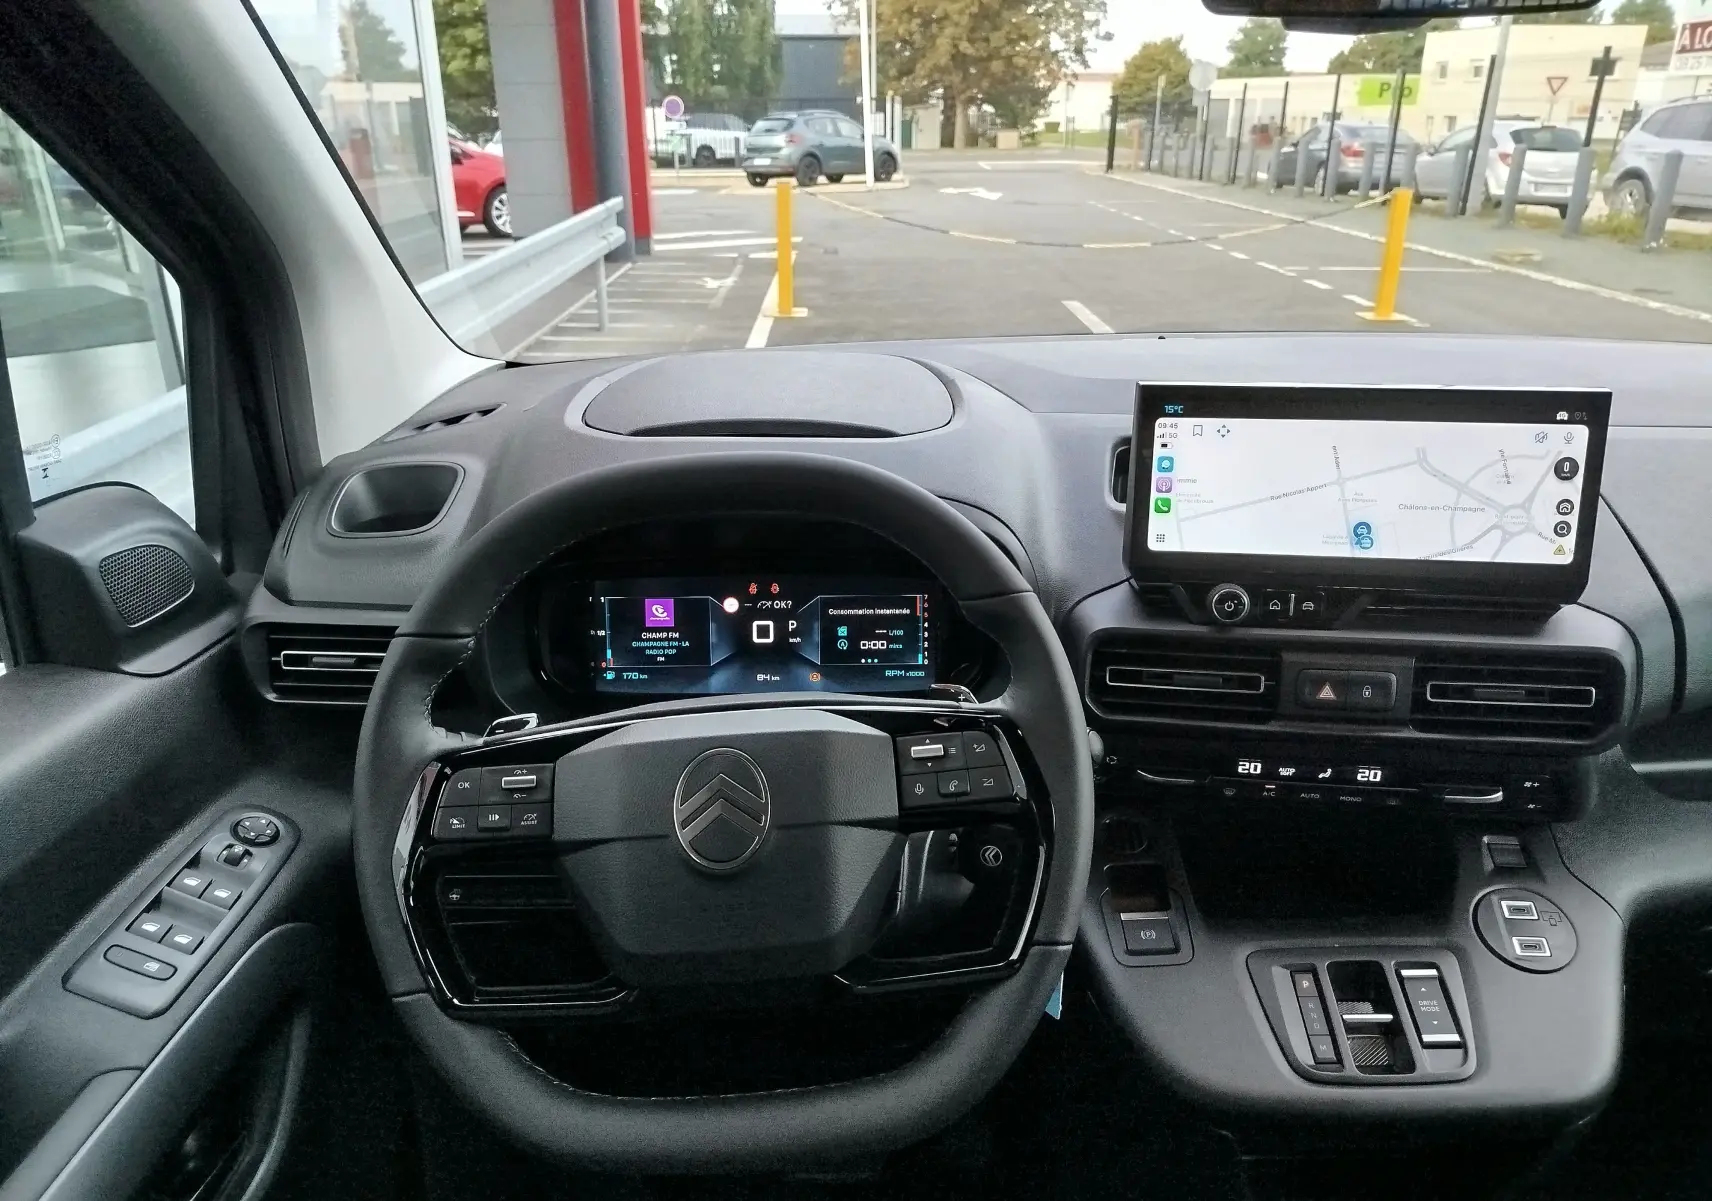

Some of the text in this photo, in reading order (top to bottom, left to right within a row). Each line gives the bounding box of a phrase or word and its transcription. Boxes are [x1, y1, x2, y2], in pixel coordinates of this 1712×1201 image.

[1164, 405, 1184, 414] 15°C
[1563, 461, 1570, 472] 0
[1283, 488, 1305, 498] Nicolas
[1306, 483, 1327, 493] Appert
[774, 601, 792, 609] OK?
[789, 620, 797, 631] P
[753, 621, 774, 643] 0
[860, 640, 887, 649] 0:00
[1237, 761, 1262, 774] 20
[1356, 769, 1382, 782] 20
[457, 781, 471, 789] OK
[1302, 980, 1310, 989] P
